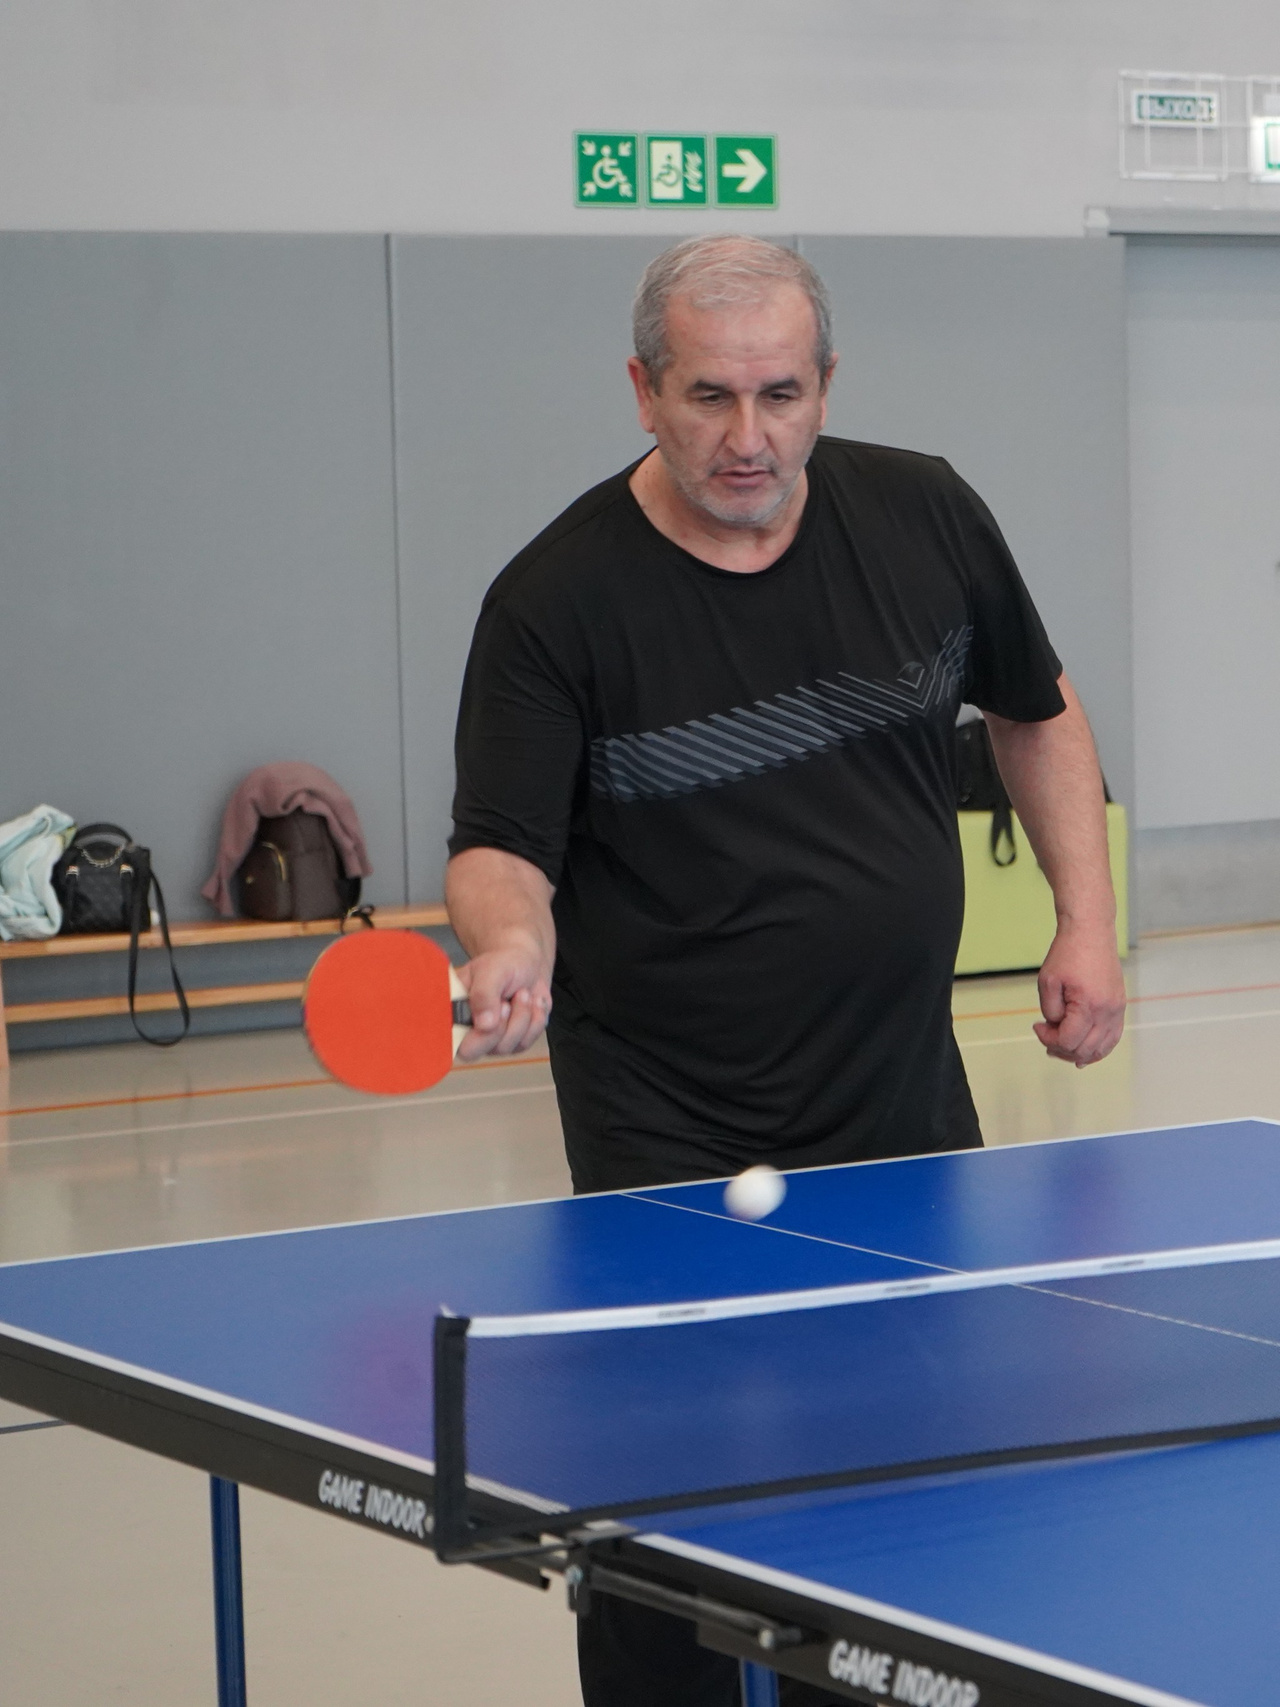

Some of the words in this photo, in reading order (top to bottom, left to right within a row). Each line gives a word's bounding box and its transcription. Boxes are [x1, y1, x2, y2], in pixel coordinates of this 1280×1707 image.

[318, 1469, 365, 1514] GAME
[364, 1483, 427, 1539] INDOOR
[828, 1638, 894, 1695] GAME
